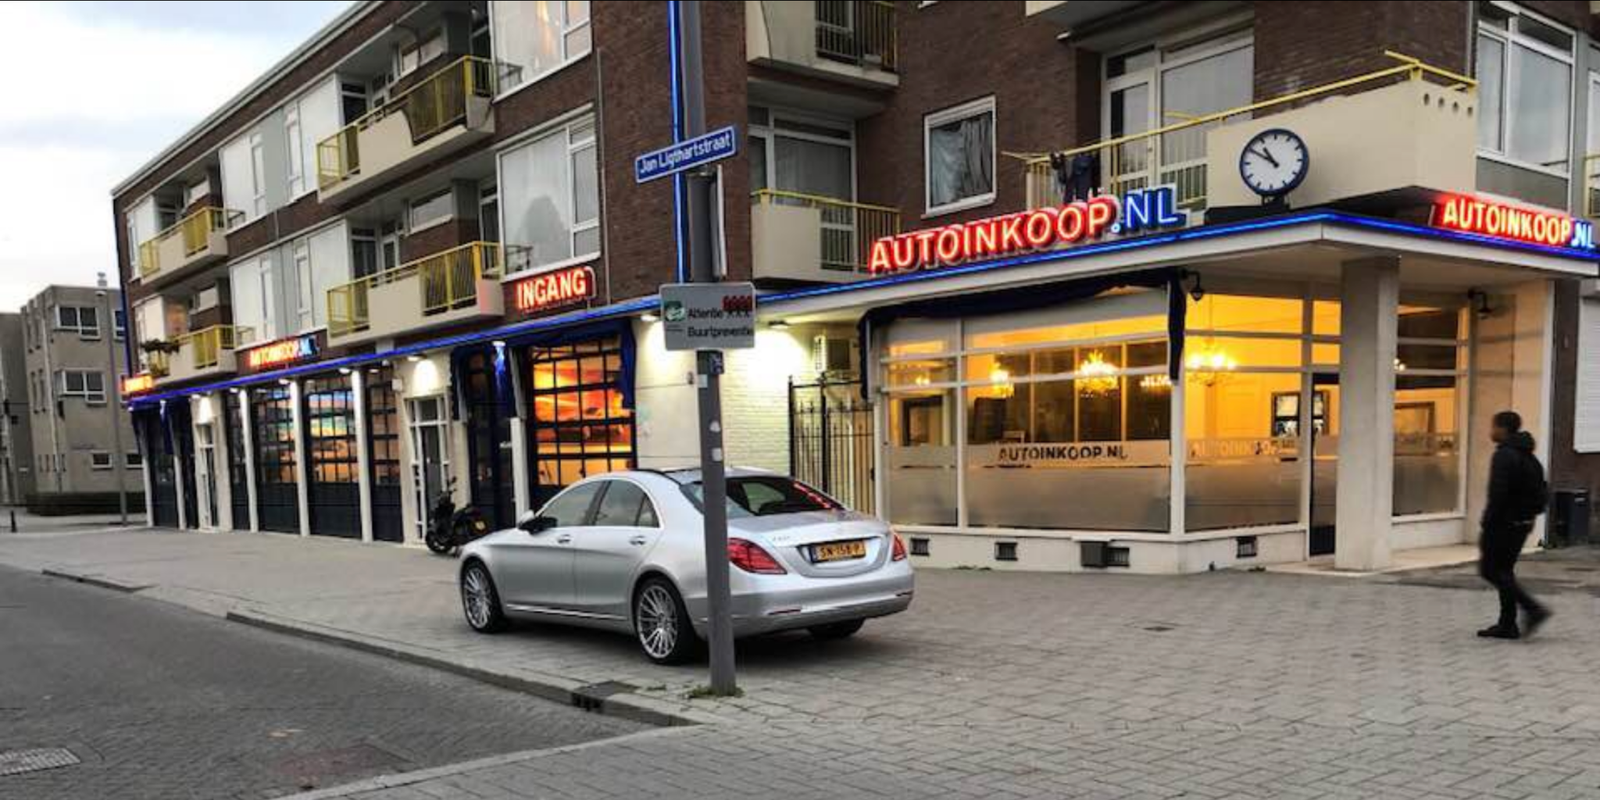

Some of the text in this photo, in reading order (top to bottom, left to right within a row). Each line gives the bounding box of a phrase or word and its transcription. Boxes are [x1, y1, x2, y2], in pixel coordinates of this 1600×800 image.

[640, 132, 731, 173] Jan Ligthartstraat
[868, 194, 1179, 272] AUTOINKOOP.NL
[1442, 198, 1596, 249] AUTOINKOOP.NL
[516, 267, 587, 310] INGANG
[687, 326, 755, 338] Buurtpreventie
[999, 445, 1128, 460] AUTOINKOOP.NL
